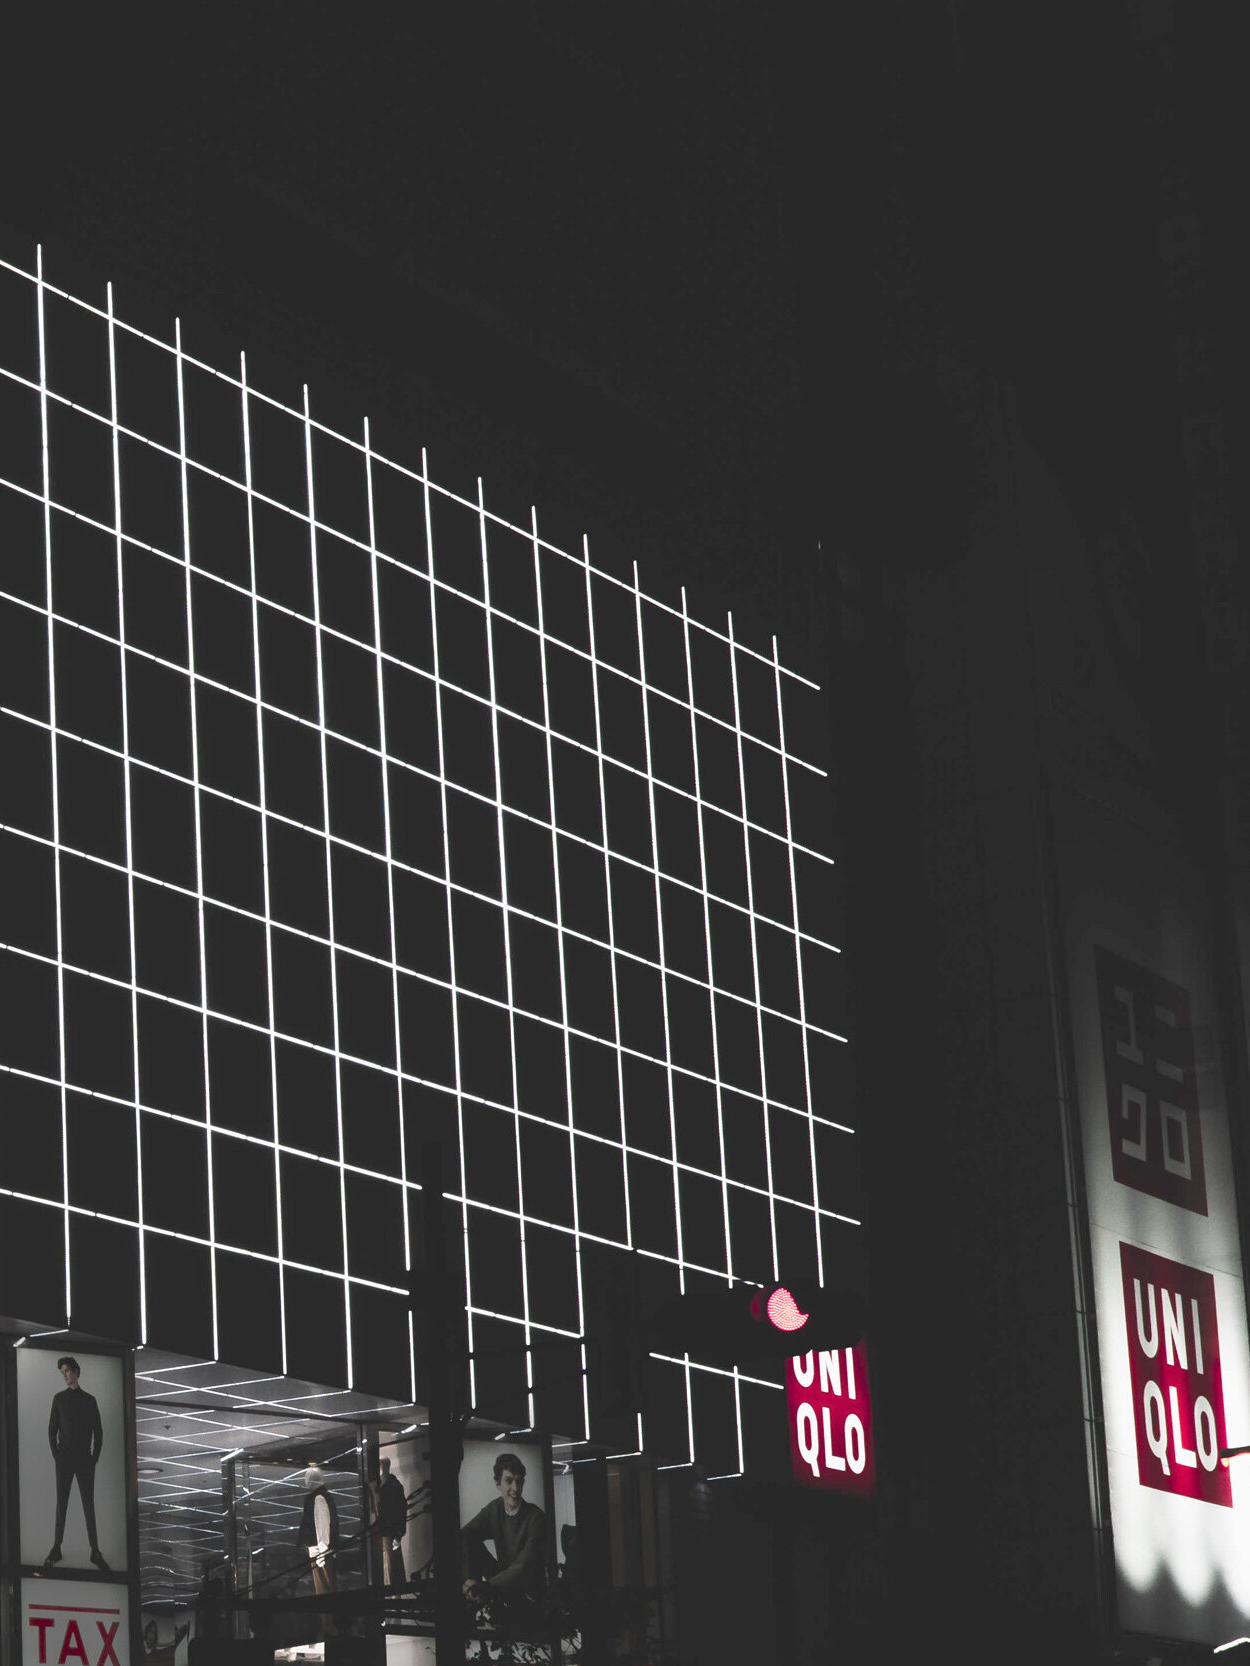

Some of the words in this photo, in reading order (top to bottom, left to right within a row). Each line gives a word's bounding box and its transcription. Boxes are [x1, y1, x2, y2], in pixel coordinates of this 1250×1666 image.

[1133, 1278, 1204, 1375] UNI
[796, 1402, 866, 1478] QLO
[1143, 1380, 1219, 1476] QLO
[28, 1617, 121, 1666] TAX
